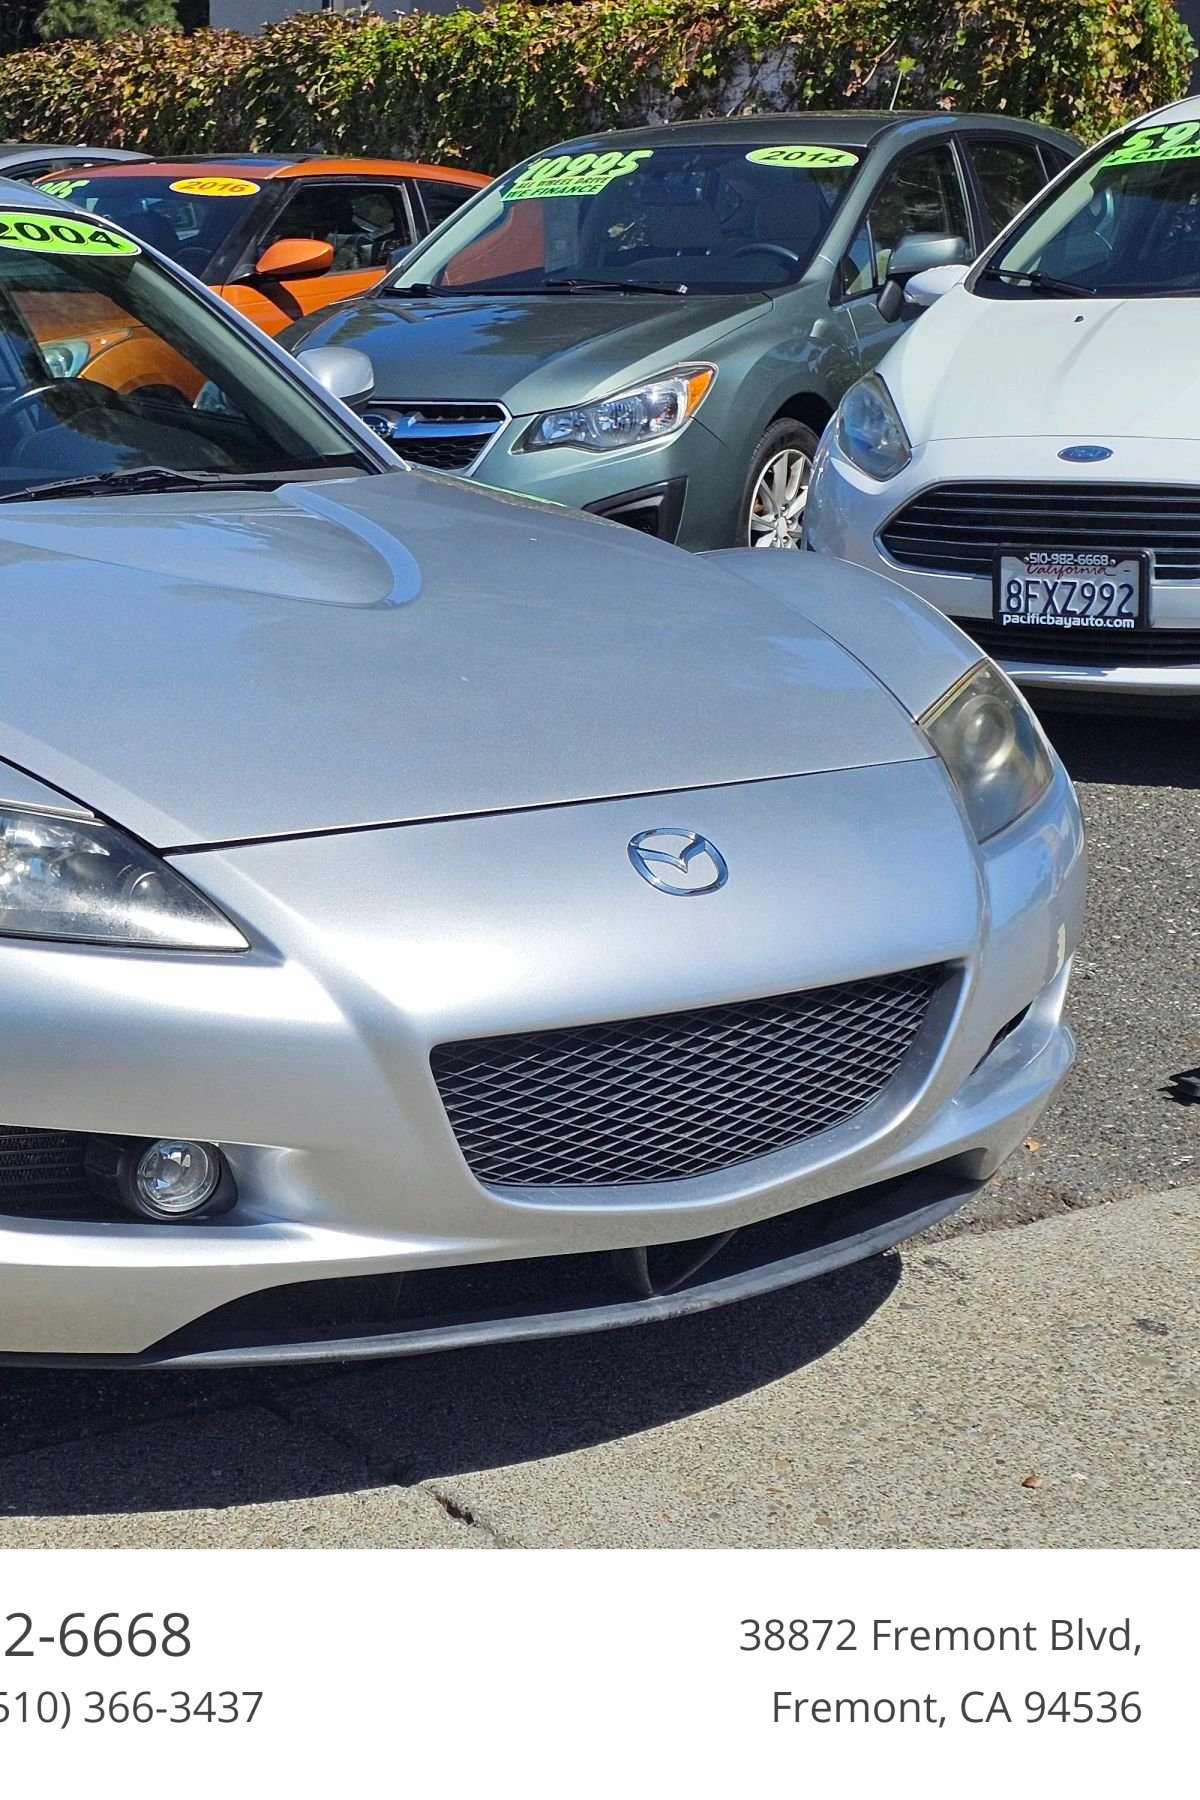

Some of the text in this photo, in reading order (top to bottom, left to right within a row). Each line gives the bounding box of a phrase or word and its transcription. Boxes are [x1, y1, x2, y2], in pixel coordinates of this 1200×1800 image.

[1114, 122, 1200, 155] 59
[759, 150, 846, 164] 2014
[514, 150, 654, 183] 10995
[182, 181, 250, 193] 2016
[536, 178, 572, 188] WHEEL
[573, 176, 610, 185] DRIVE
[505, 184, 602, 199] WE FINANCE
[1029, 552, 1109, 565] 510-982-6668
[1026, 564, 1116, 580] California
[1005, 579, 1135, 617] 8FXZ992
[1002, 613, 1135, 629] pacificbayauto.com
